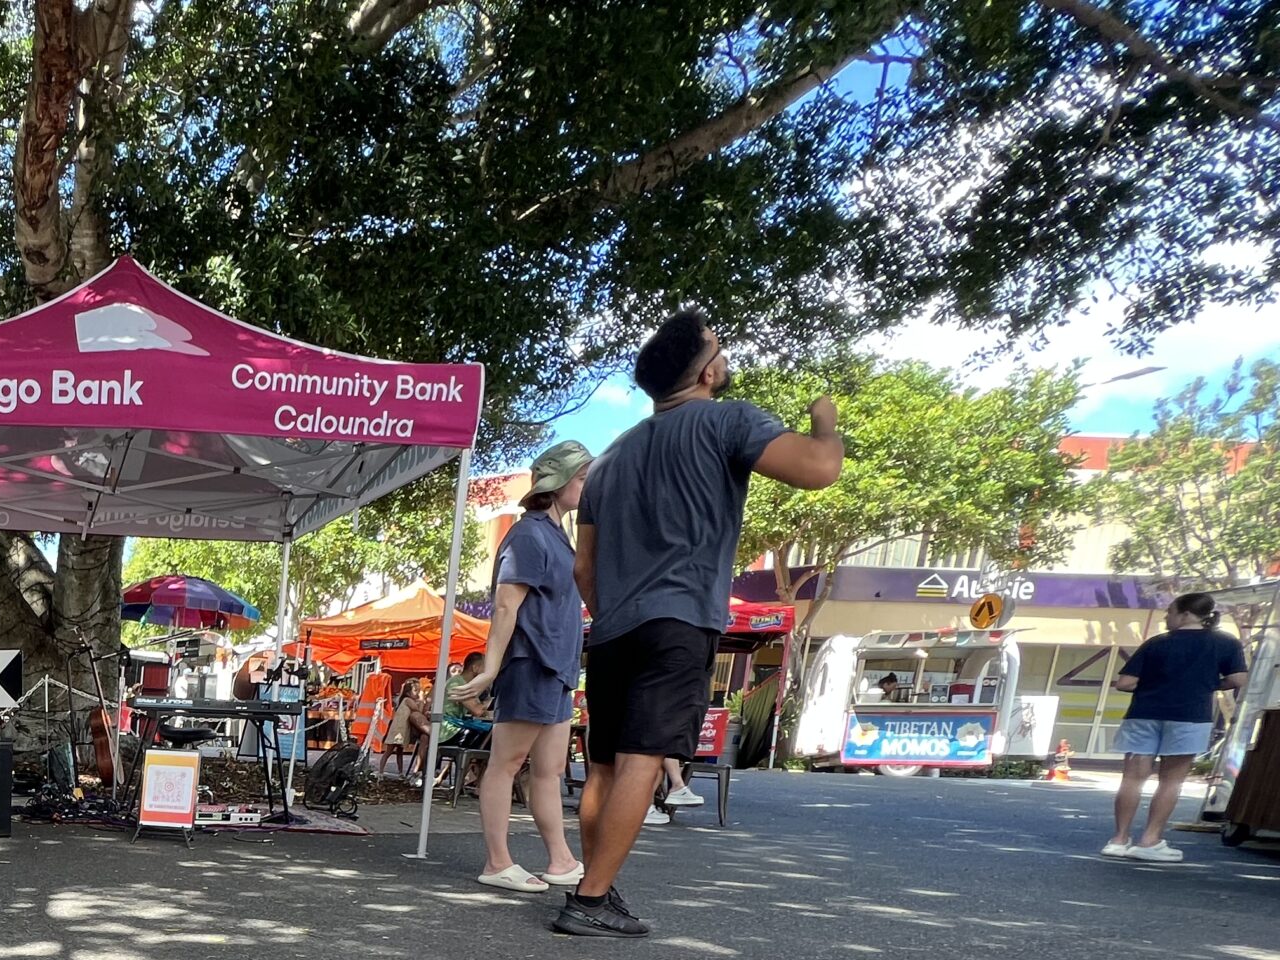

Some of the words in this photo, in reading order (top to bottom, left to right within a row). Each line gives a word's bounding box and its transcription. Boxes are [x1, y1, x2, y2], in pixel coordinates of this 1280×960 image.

[51, 369, 143, 405] Bank
[231, 363, 388, 406] Community
[395, 374, 464, 402] Bank
[274, 405, 414, 437] Caloundra
[951, 575, 1035, 600] Auie
[885, 721, 953, 738] TIBETAN
[880, 738, 951, 756] MOMOS
